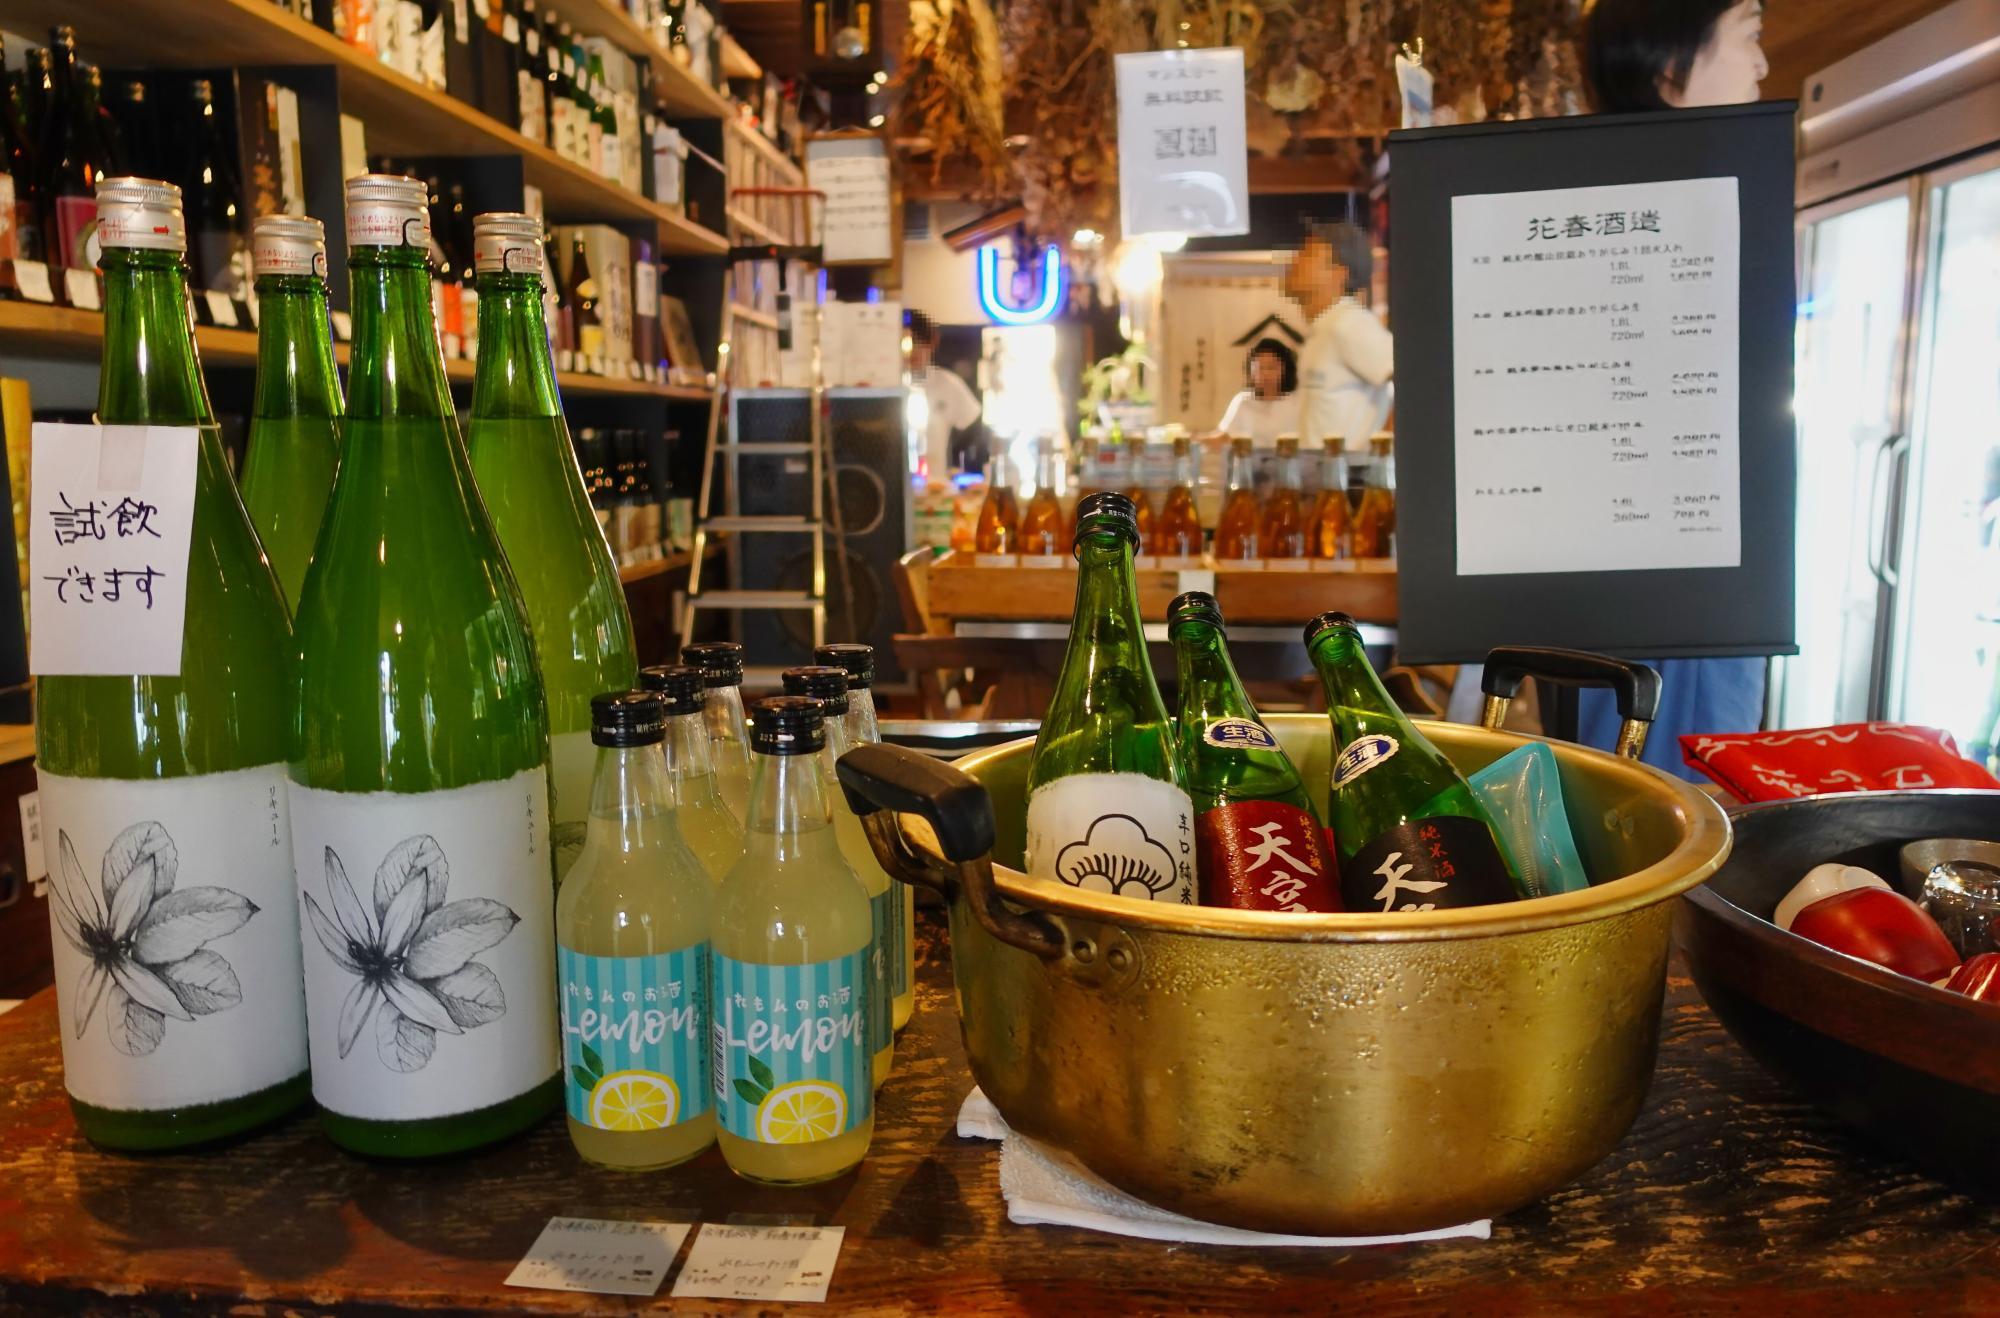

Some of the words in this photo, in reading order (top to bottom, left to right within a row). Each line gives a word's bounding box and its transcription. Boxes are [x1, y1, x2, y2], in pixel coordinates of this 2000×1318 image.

[1527, 209, 1662, 241] 花春酒造
[49, 491, 161, 546] 試飲
[43, 565, 166, 609] できます
[269, 785, 280, 847] リキュール
[526, 793, 536, 857] リキュール
[1418, 825, 1455, 879] 純米酒
[1372, 851, 1448, 912] 天
[562, 985, 698, 1054] Lemon
[569, 981, 682, 1003] れもんのお酒
[734, 986, 851, 1012] れもんのお酒
[725, 997, 864, 1063] Lemon
